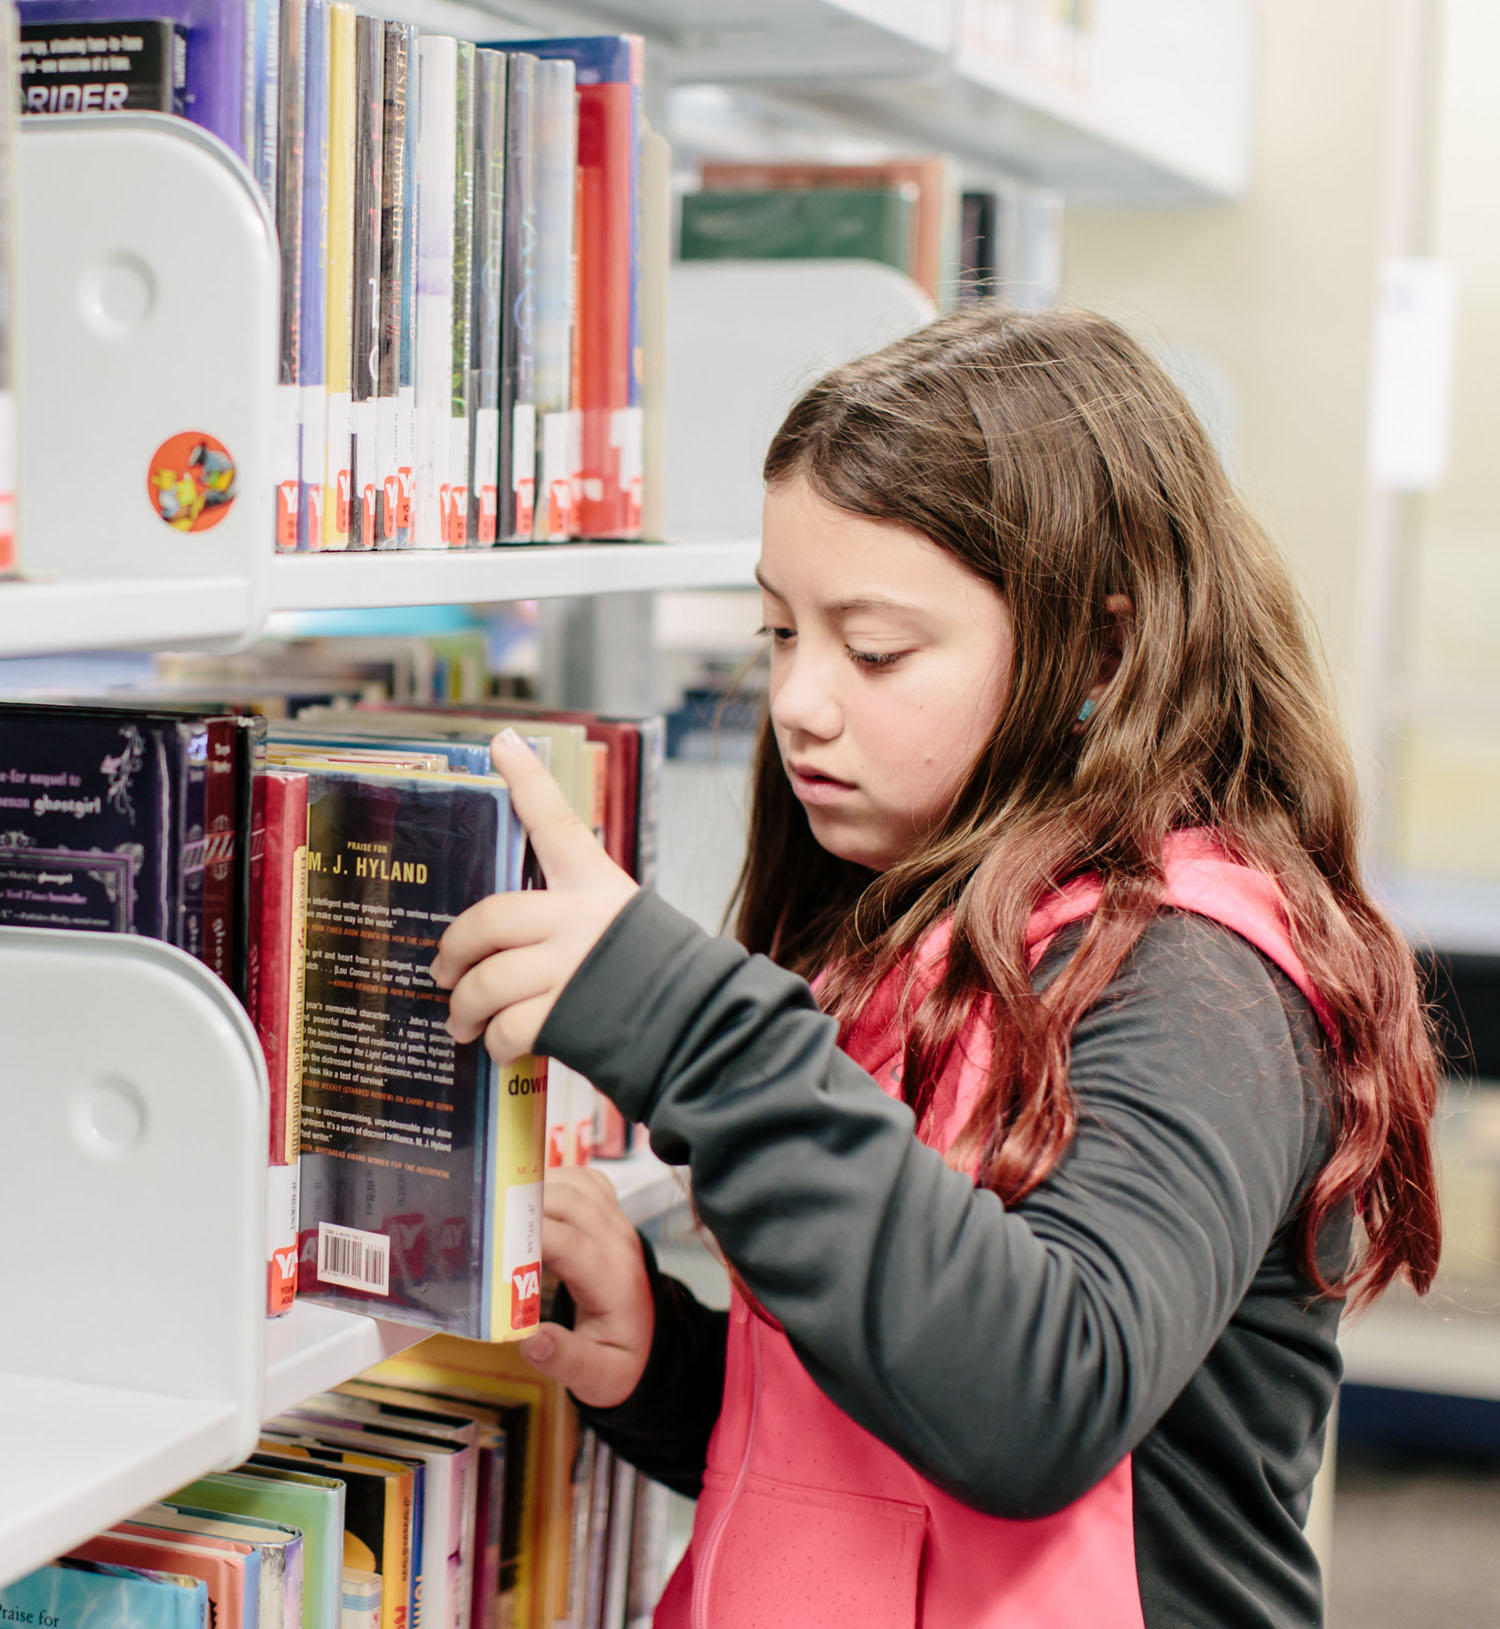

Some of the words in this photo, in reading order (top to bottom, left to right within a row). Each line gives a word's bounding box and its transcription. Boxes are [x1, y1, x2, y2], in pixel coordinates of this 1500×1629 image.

[27, 83, 129, 112] RIDER
[395, 50, 407, 125] LESLEY
[0, 769, 27, 784] e-for
[29, 772, 67, 788] sequel
[69, 774, 81, 787] to
[33, 793, 101, 819] ghostgirl
[347, 841, 371, 852] PRAISE
[373, 843, 388, 854] FOR
[308, 851, 328, 873] M.
[332, 854, 348, 875] J.
[355, 856, 429, 885] HYLAND
[313, 896, 341, 908] intelligent
[365, 917, 375, 926] the
[338, 953, 353, 962] heart
[355, 955, 370, 965] from
[349, 968, 371, 978] Connor
[325, 1005, 357, 1015] memorable
[359, 1010, 390, 1020] characters
[313, 1016, 339, 1025] powerful
[342, 1020, 377, 1032] throughout.
[398, 1028, 404, 1036] A
[307, 1027, 317, 1035] the
[317, 1028, 358, 1042] bewilderment
[358, 1036, 370, 1044] and
[400, 1042, 408, 1050] of
[309, 1040, 338, 1053] (following
[339, 1045, 353, 1054] How
[354, 1048, 365, 1056] the
[365, 1050, 381, 1059] Light
[382, 1052, 396, 1061] Gets
[309, 1066, 321, 1075] look
[322, 1069, 333, 1077] like
[340, 1072, 352, 1080] test
[352, 1074, 360, 1082] of
[310, 1053, 321, 1062] the
[321, 1056, 352, 1067] distressed
[352, 1060, 365, 1070] lens
[366, 1063, 373, 1071] of
[413, 1072, 433, 1080] which
[433, 1076, 455, 1085] makes
[290, 1082, 301, 1157] Valentine
[316, 1106, 322, 1114] is
[323, 1109, 373, 1126] uncompromising,
[422, 1127, 435, 1135] and
[327, 1121, 336, 1130] It's
[356, 1127, 363, 1135] of
[430, 1141, 452, 1152] Hyland
[513, 1271, 540, 1300] YA
[0, 1603, 34, 1624] raise
[38, 1608, 60, 1628] for
